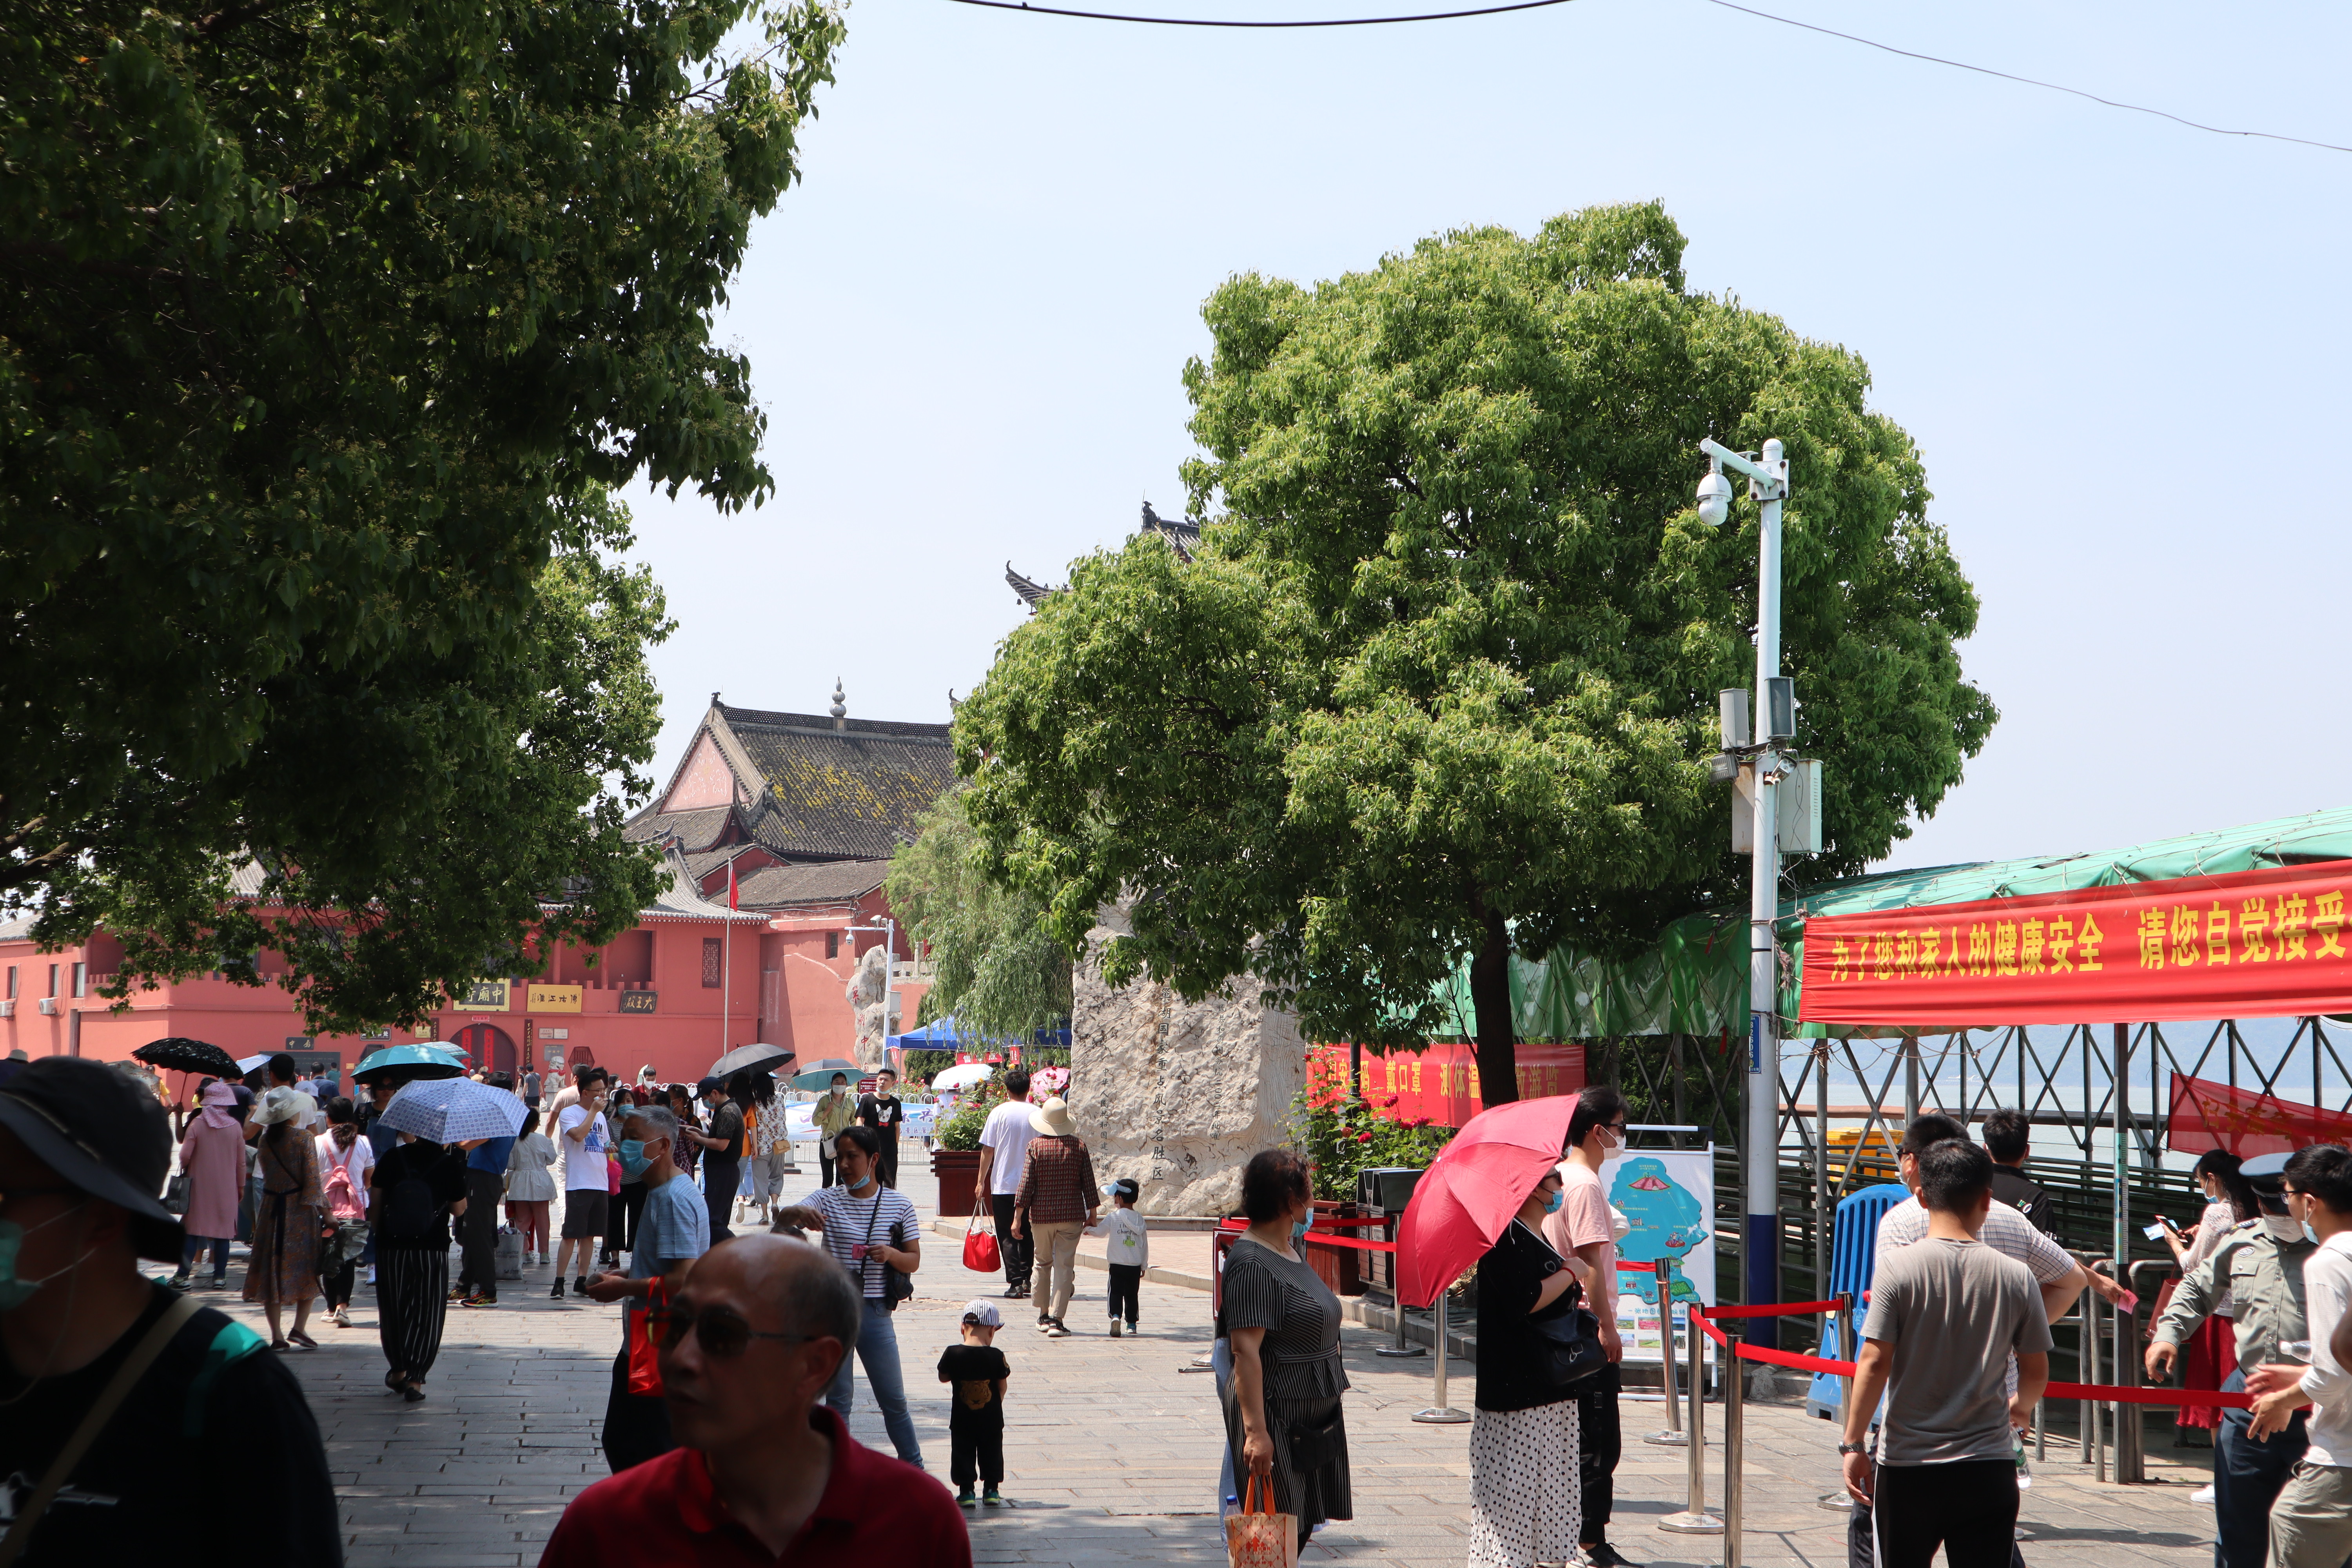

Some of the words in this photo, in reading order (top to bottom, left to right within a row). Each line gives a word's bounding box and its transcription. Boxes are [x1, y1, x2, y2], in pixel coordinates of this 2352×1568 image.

[1831, 912, 2104, 982] 为了您和家人的健康安全
[2137, 889, 2352, 970] 请您自觉接受
[1151, 987, 1171, 1180] 巢湖国家重点风景名胜区
[1327, 1058, 1370, 1092] 扫安码
[1386, 1060, 1421, 1096] 戴口罩
[1440, 1062, 1480, 1098] 测体温
